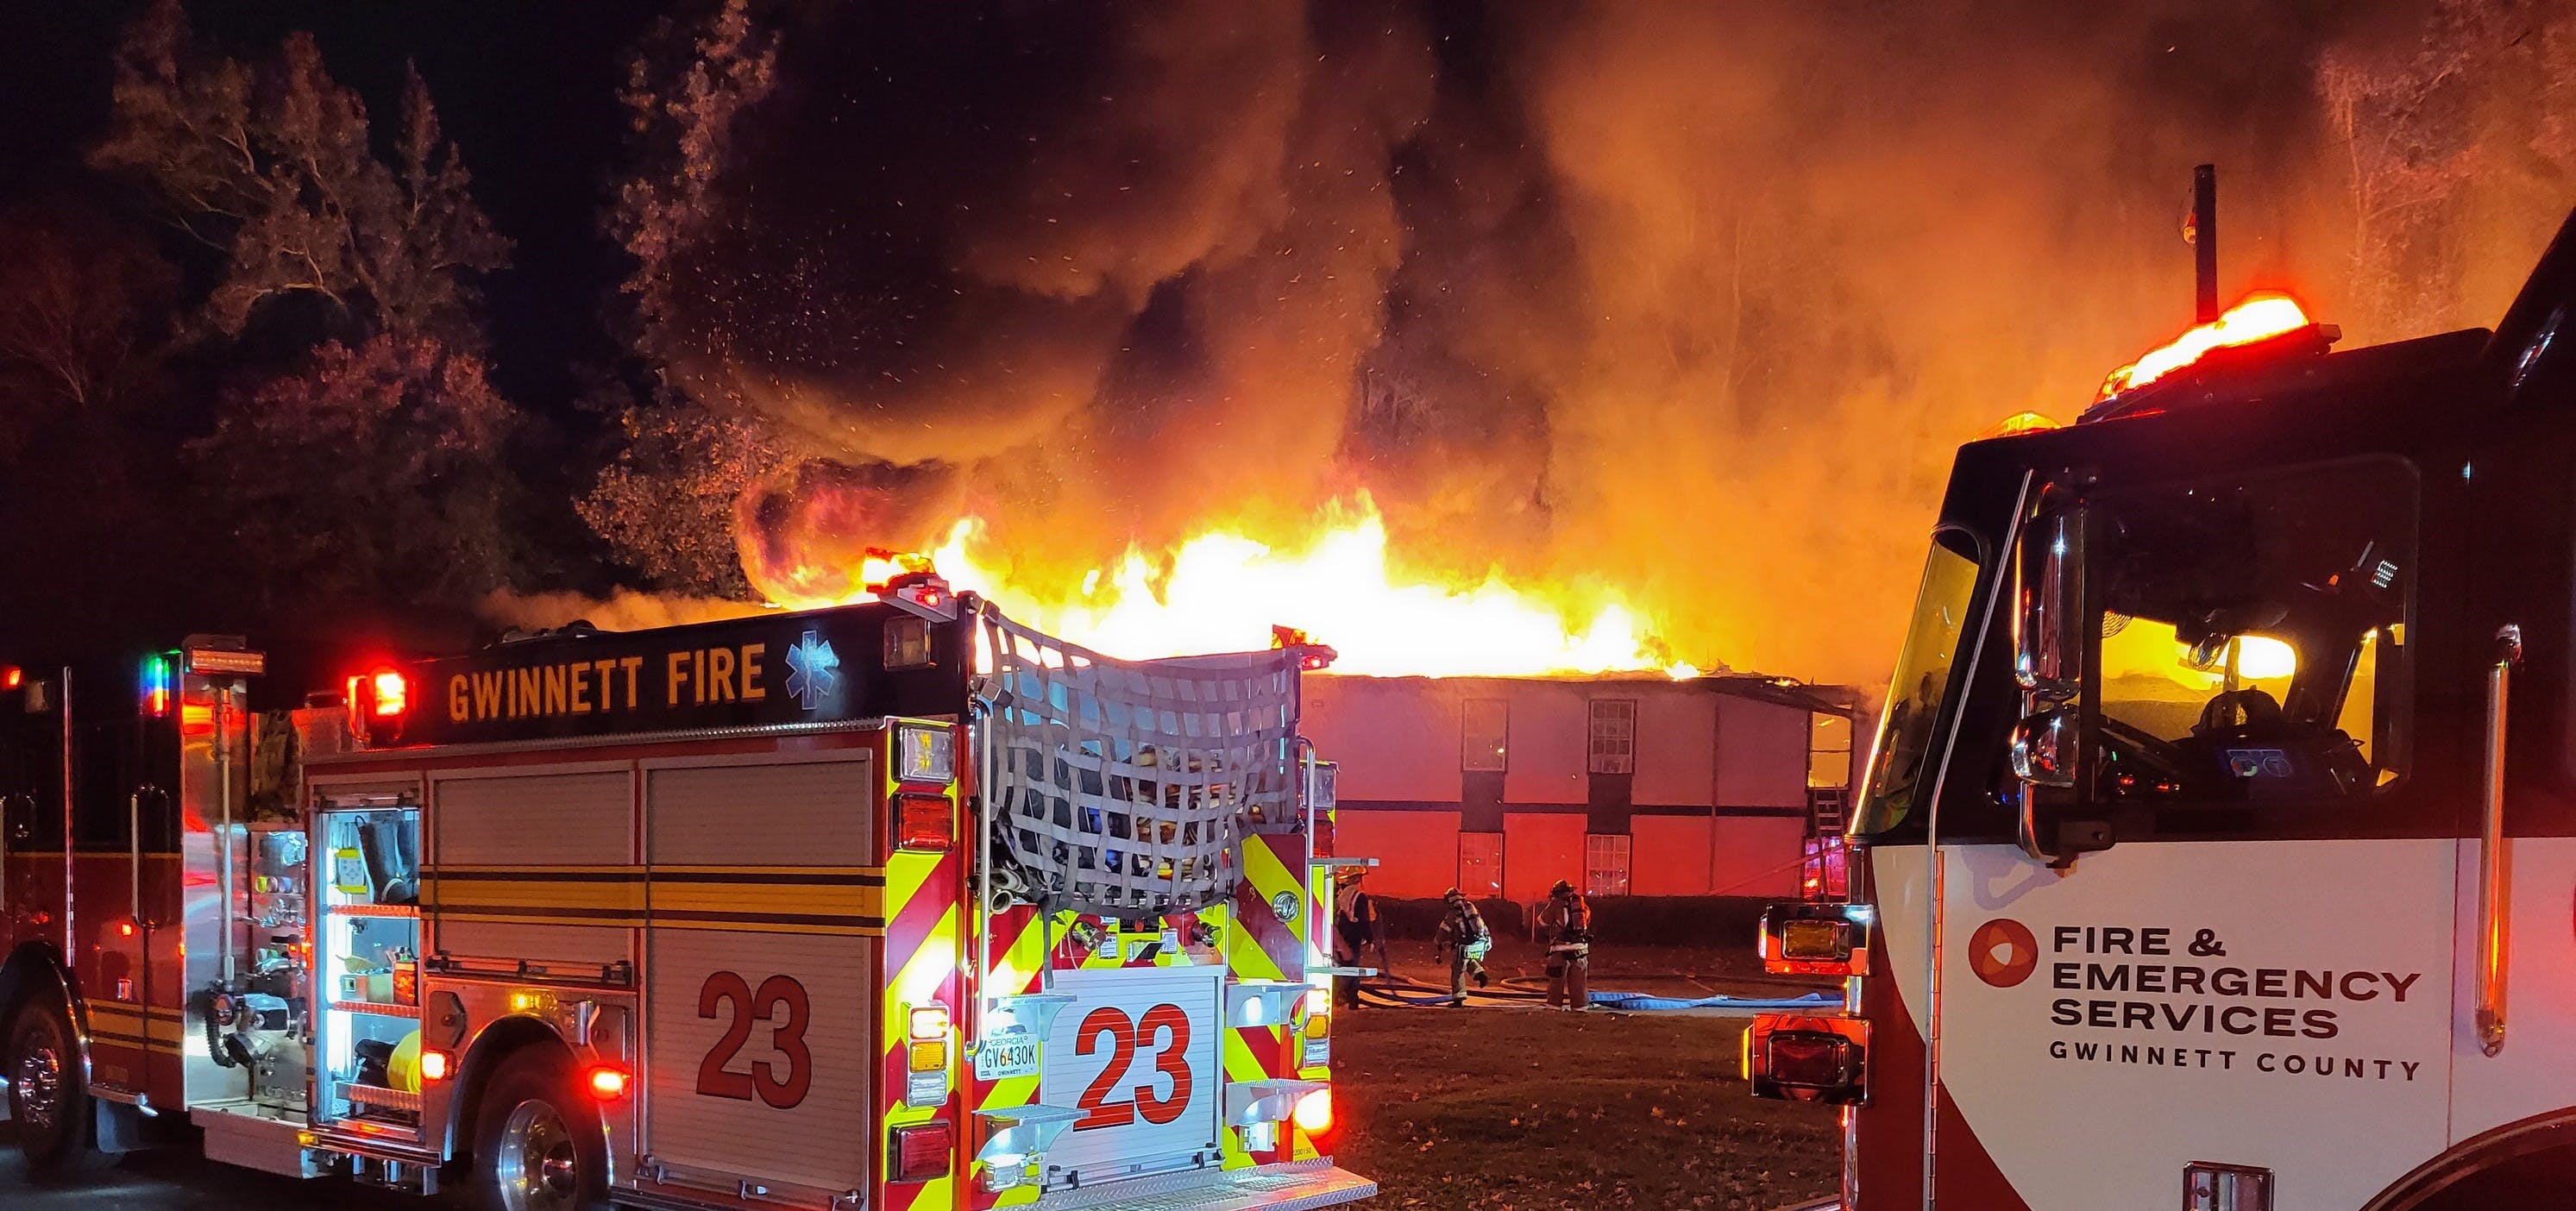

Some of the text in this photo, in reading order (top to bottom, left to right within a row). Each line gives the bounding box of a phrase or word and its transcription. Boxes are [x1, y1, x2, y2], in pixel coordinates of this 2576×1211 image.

[449, 643, 767, 723] GWINNETT FIRE
[2053, 926, 2227, 957] FIRE &
[2053, 963, 2422, 1002] EMERGENCY
[2051, 999, 2340, 1039] SERVICES
[696, 971, 812, 1109] 23
[985, 1045, 1035, 1068] GV6430K
[990, 1036, 1025, 1047] GEORGIA
[1072, 1003, 1192, 1133] 23
[2050, 1040, 2421, 1082] GWINNETT COUNTY
